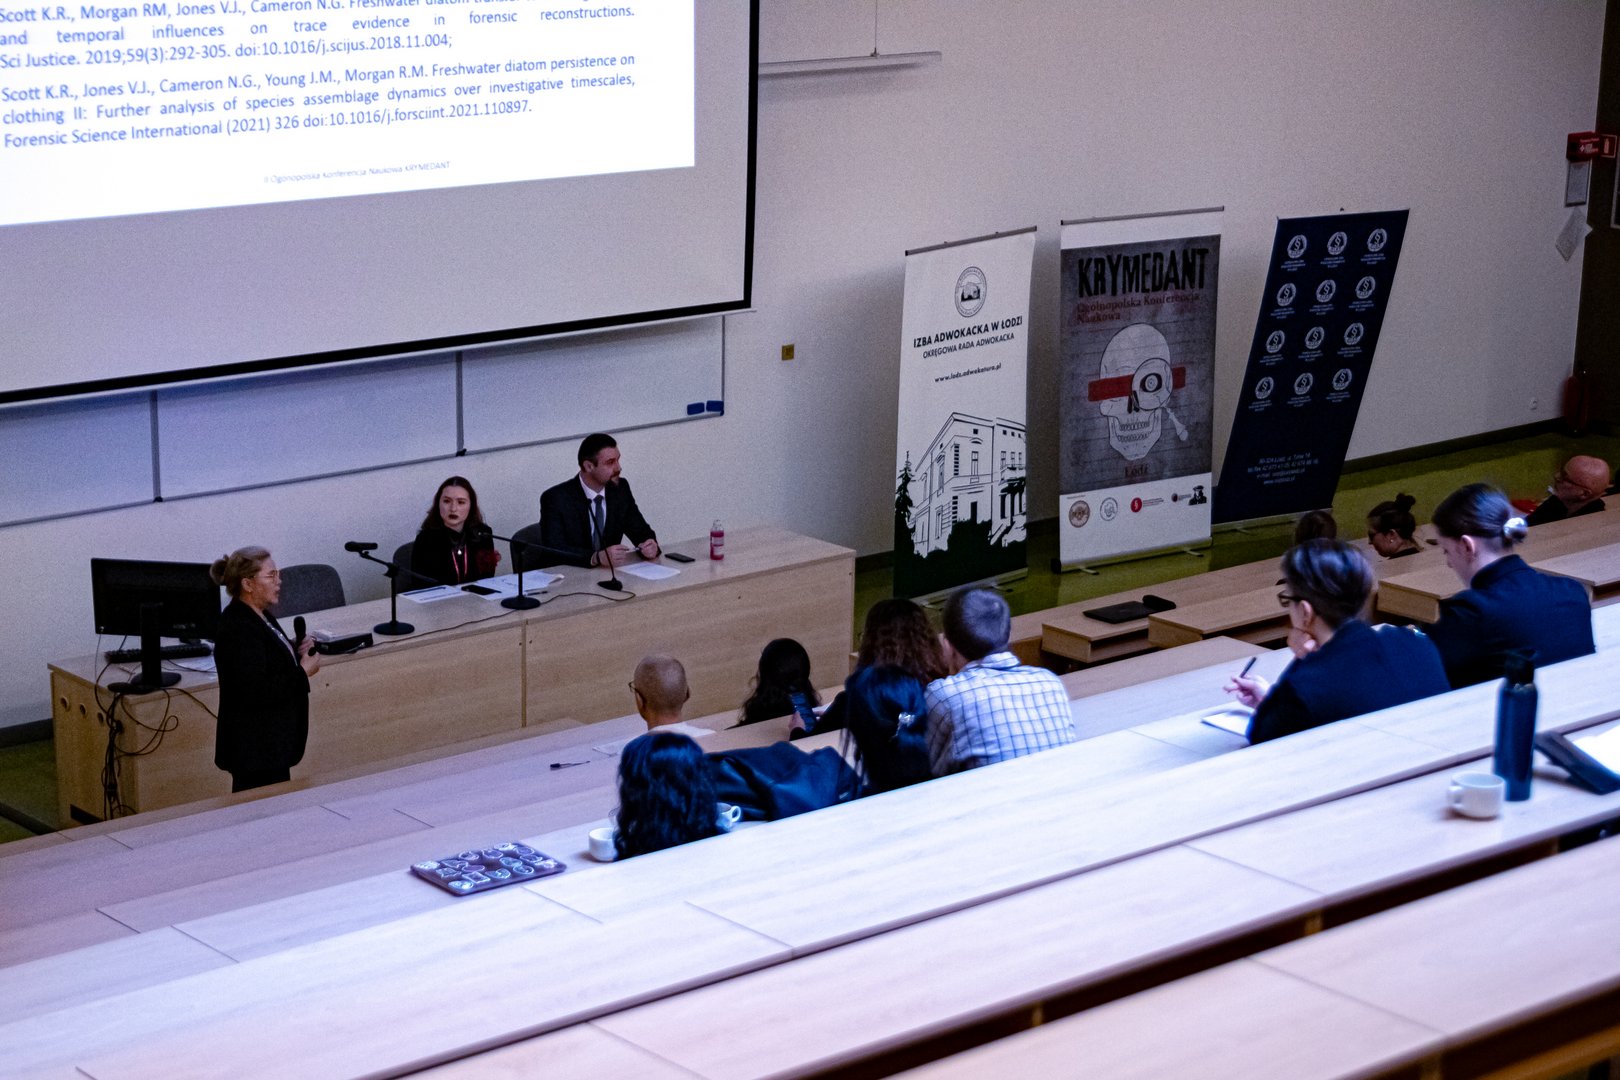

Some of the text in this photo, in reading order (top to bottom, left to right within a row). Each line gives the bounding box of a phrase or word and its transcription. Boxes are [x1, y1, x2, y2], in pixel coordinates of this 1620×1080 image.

[0, 8, 37, 23] Scott
[42, 6, 75, 22] K.R.,
[81, 5, 137, 22] Morgan
[143, 3, 170, 18] RM,
[176, 2, 216, 16] Jones
[220, 0, 246, 15] V.J.,
[251, 0, 312, 12] Cameron
[0, 6, 635, 46] and temporal influences on trace evidence in forensic reconstructions.
[0, 34, 452, 69] Sci Justice. 2019;59(3):292-305. doi:10.1016/j.scijus.2018.11.004;
[1, 55, 635, 101] Scott K.R., Jones V.J., Cameron N.G., Young J.M., Morgan R.M. Freshwater diatom persistence on
[2, 73, 635, 124] clothing II: Further analysis of species assemblage dynamics over investigative timescales,
[4, 99, 532, 148] Forensic Science International (2021) 326 doi:10.1016/j.forsciint.2021.110897.
[1077, 248, 1210, 298] KRYMEDANT
[913, 315, 1023, 348] IZBA ADWOKACKA W ŁODZI
[922, 332, 1015, 359] OKRĘGOWA RADA ADWOKACKA
